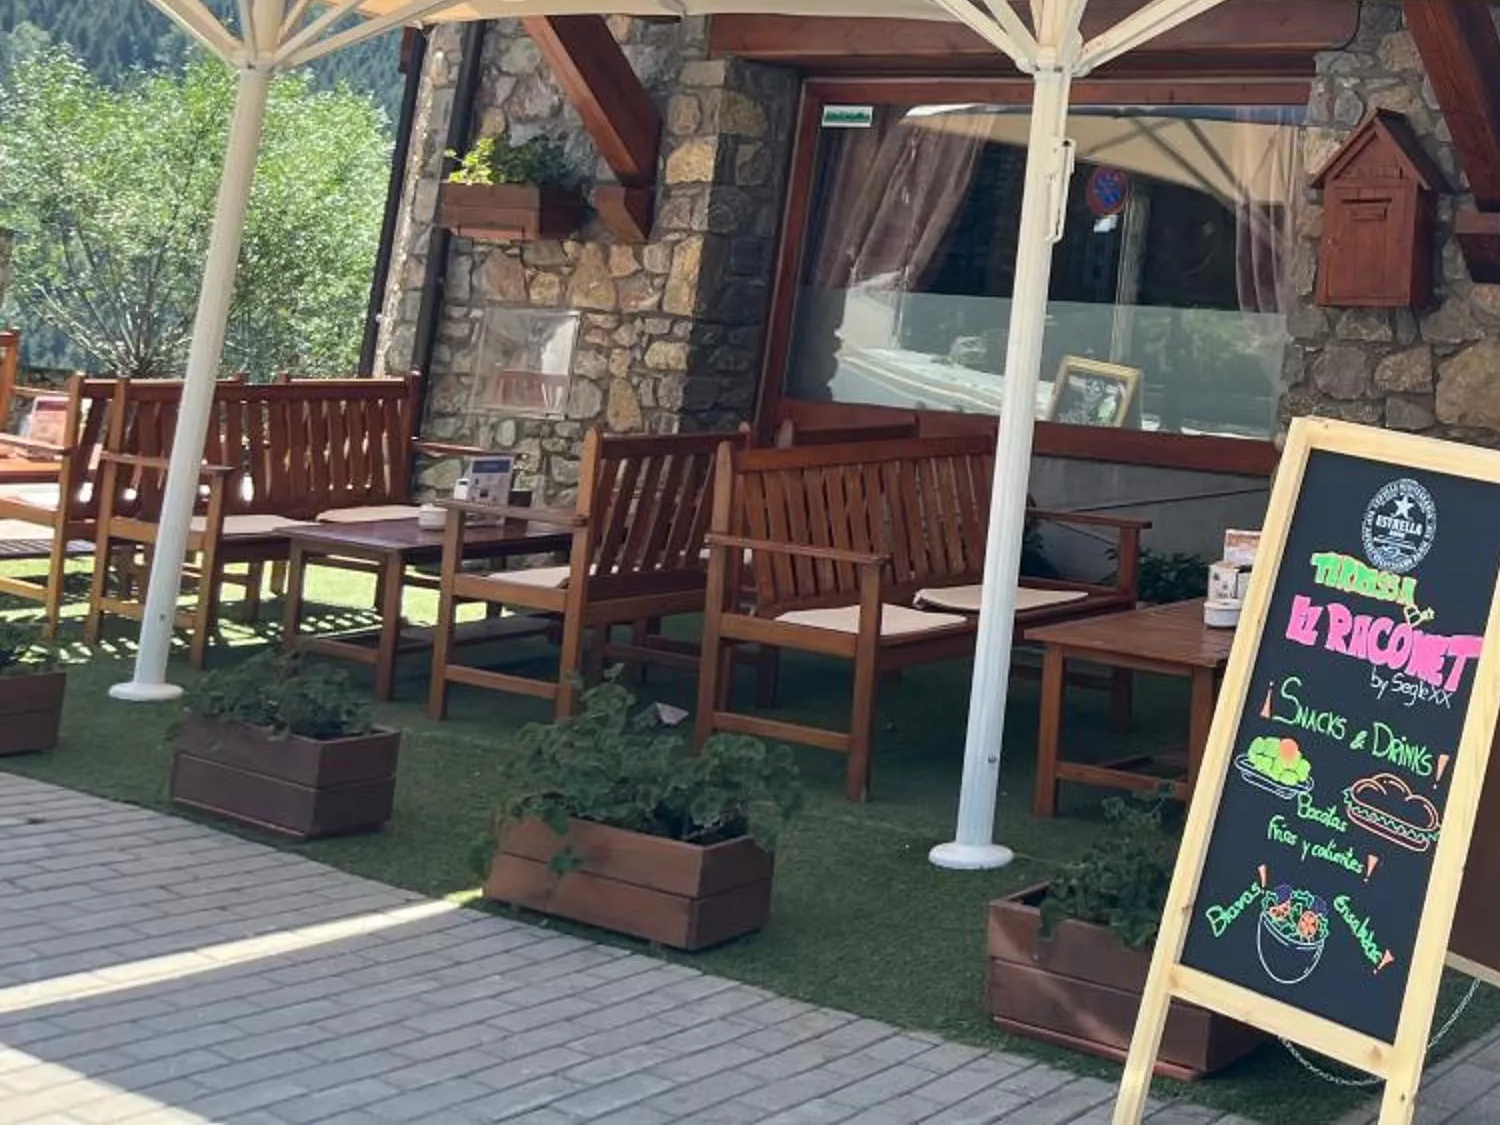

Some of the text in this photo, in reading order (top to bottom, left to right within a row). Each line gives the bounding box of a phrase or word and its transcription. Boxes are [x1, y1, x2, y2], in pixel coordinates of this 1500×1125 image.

[1375, 514, 1423, 536] ESTRELLA
[1286, 594, 1484, 692] EL RACONET
[1369, 666, 1389, 700] by
[1350, 730, 1368, 750] &
[1302, 838, 1313, 862] y
